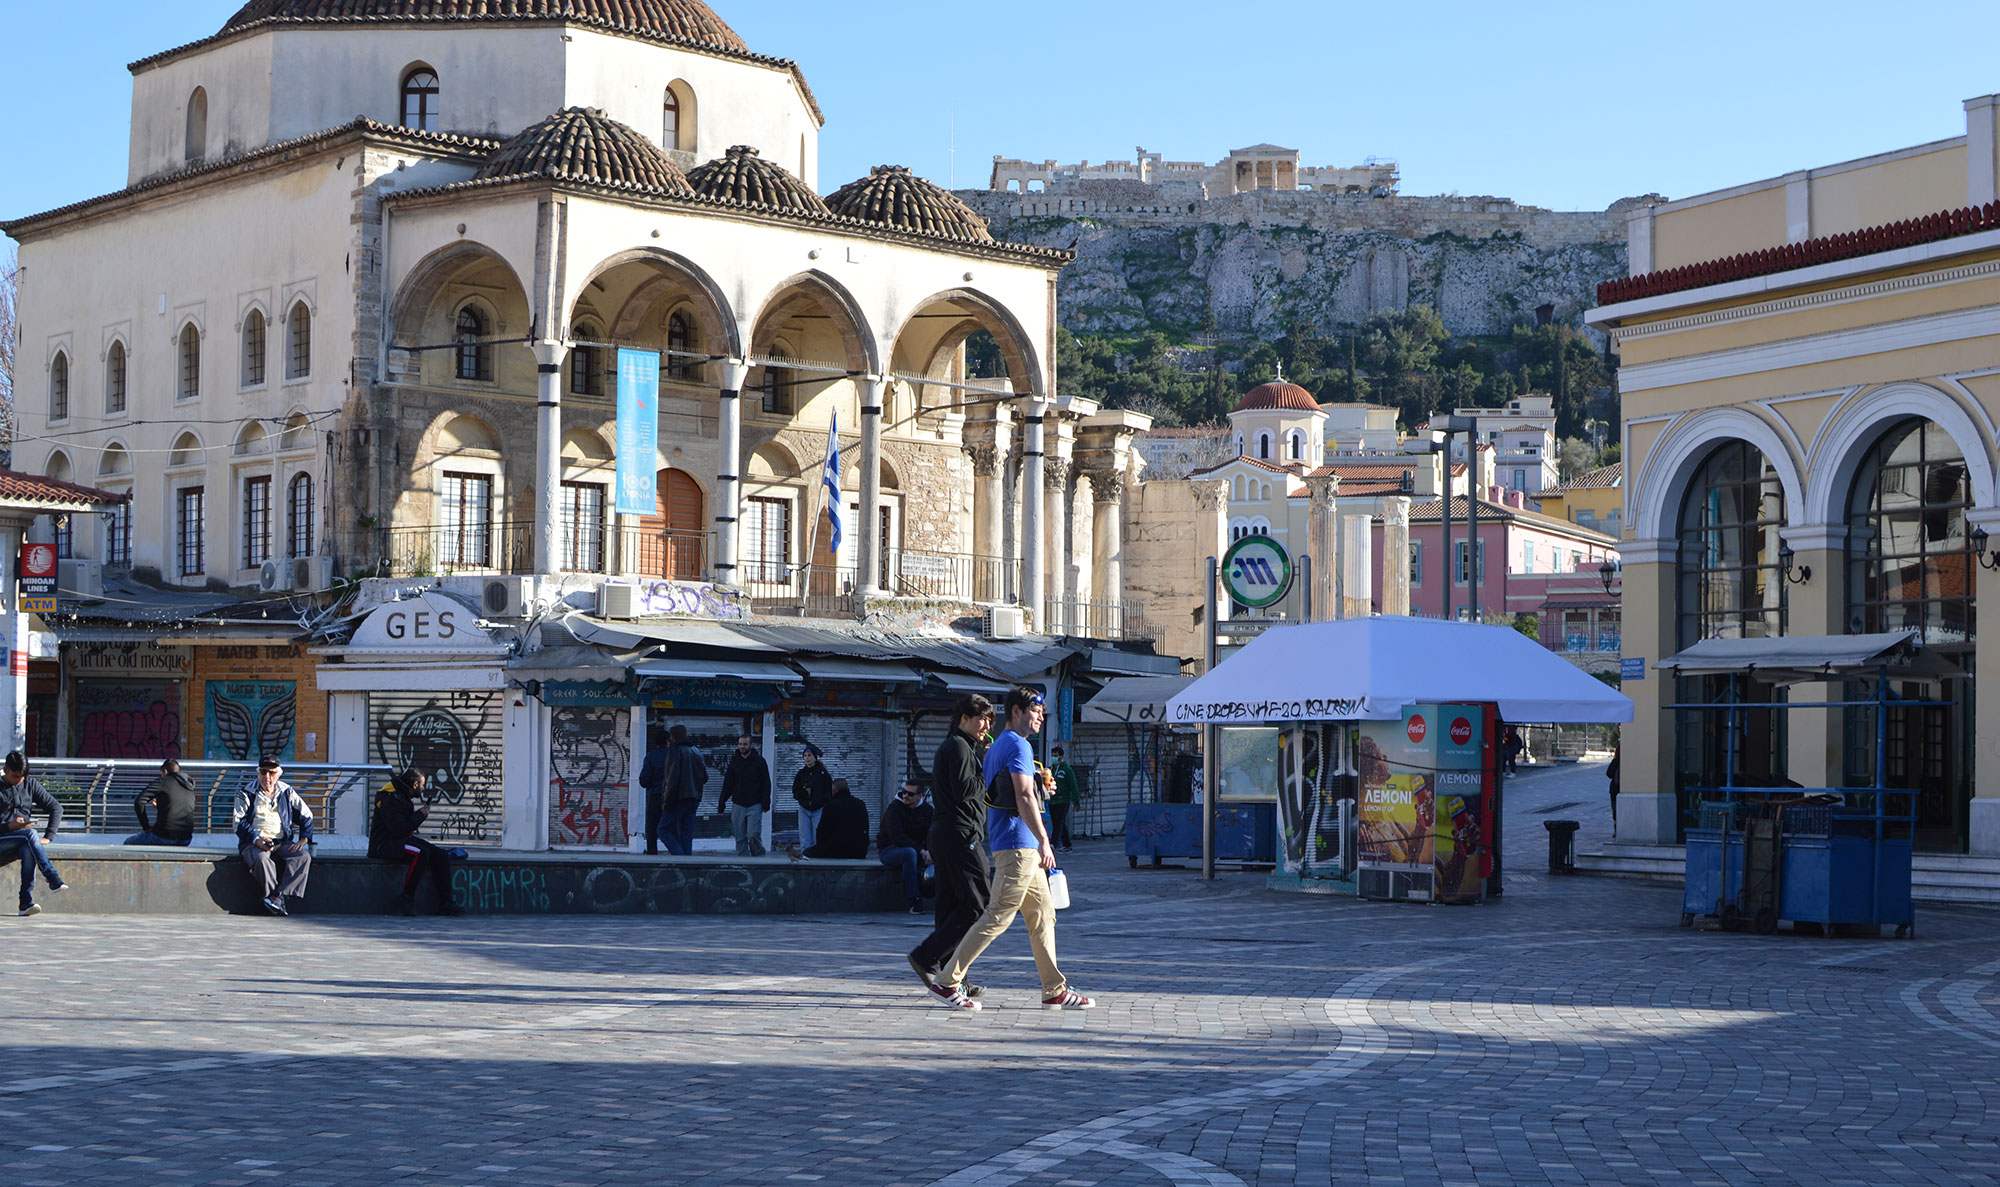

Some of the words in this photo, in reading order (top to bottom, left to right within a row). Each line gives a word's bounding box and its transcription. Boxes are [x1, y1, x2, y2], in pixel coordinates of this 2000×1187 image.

[22, 577, 55, 585] MINOAN
[24, 600, 53, 610] ATM
[386, 611, 455, 639] GES
[216, 645, 258, 660] MATER
[265, 644, 302, 660] TERRA
[80, 651, 94, 668] in
[96, 651, 116, 668] the
[118, 651, 137, 668] old
[141, 654, 186, 671] mosque
[553, 689, 578, 698] GREEK
[690, 687, 746, 699] SOUVENIRS
[1439, 774, 1481, 785] ΛΕΜΟΝΙ
[1364, 789, 1412, 805] ΛΕΜΟΝΙ
